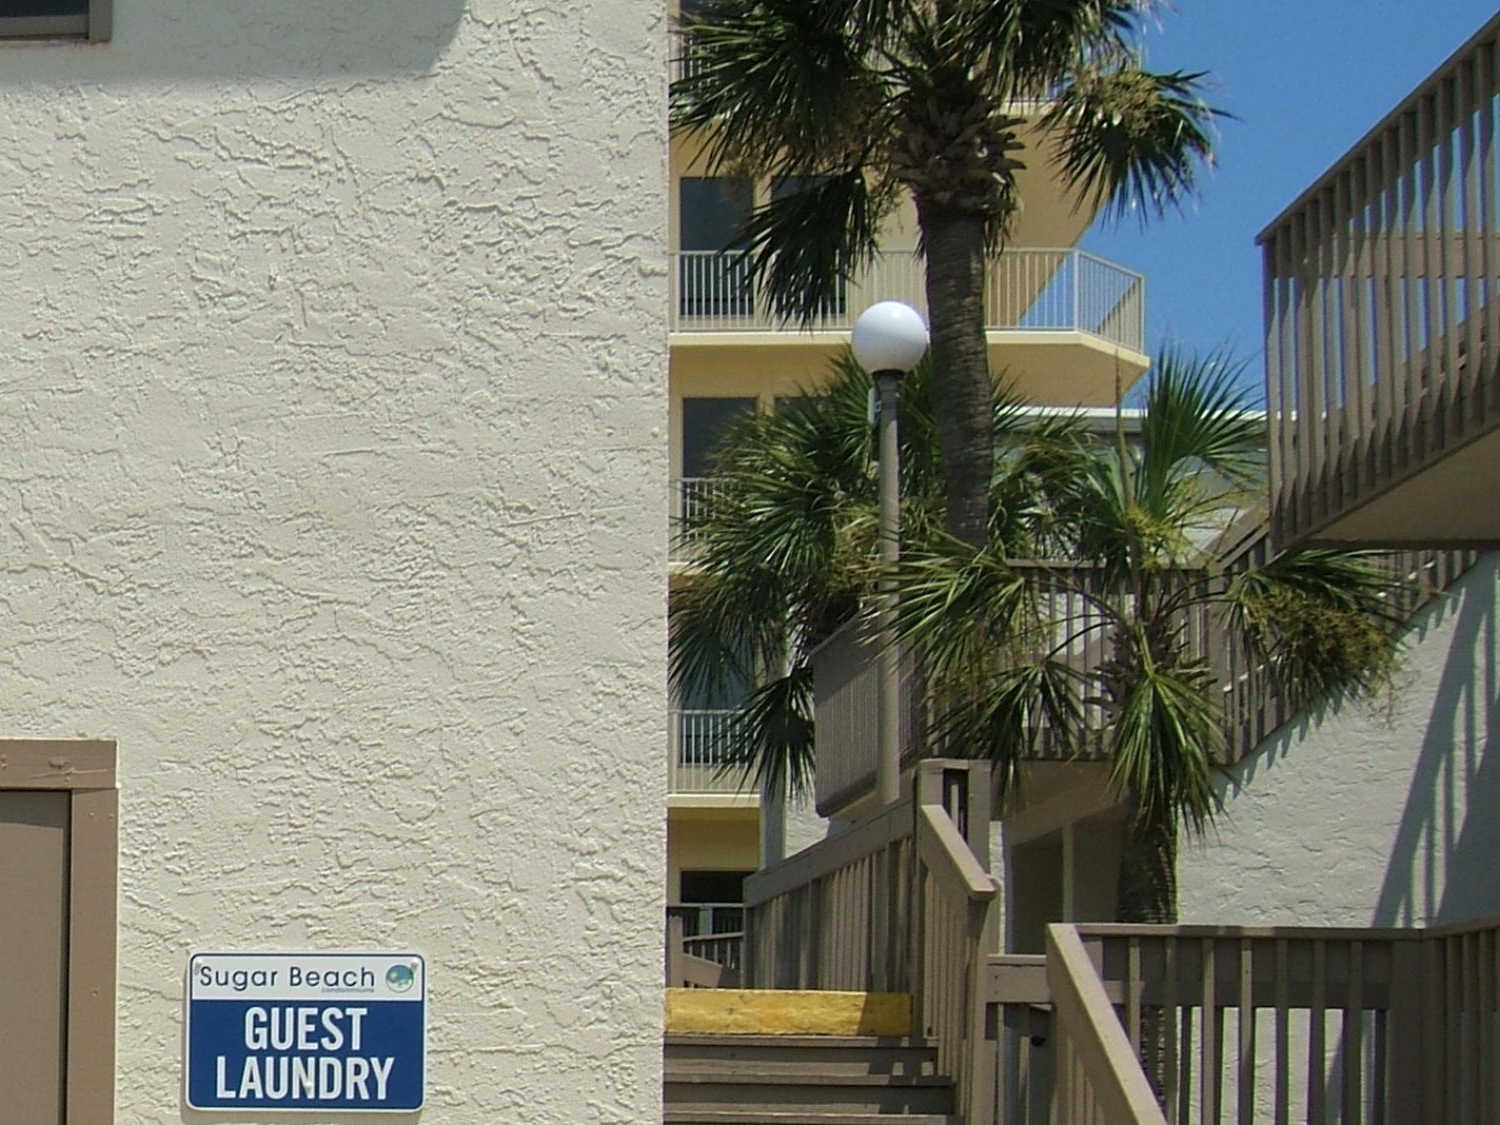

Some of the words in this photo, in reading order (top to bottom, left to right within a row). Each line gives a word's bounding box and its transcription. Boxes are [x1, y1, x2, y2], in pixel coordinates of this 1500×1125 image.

[200, 966, 278, 992] Sugar
[289, 966, 375, 987] Beach
[245, 1007, 367, 1050] GUEST
[216, 1056, 394, 1099] LAUNDRY
